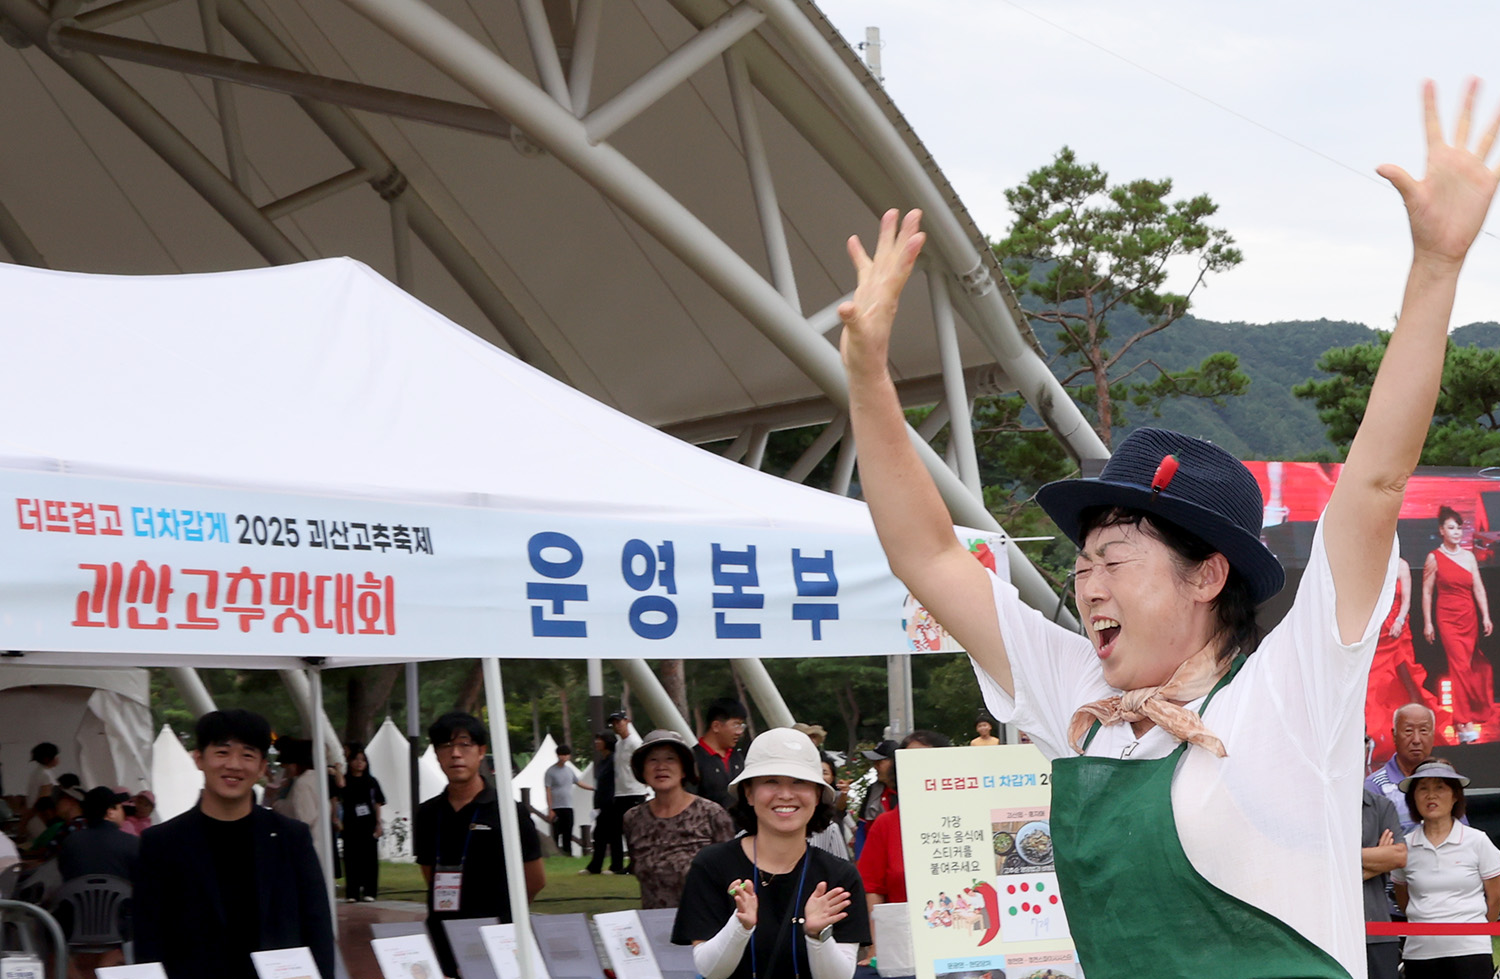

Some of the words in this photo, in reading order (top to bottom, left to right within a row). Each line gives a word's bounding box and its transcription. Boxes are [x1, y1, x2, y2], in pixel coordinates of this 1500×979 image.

[16, 498, 123, 537] 더뜨겁고
[131, 506, 230, 544] 더차갑게
[236, 514, 300, 548] 2025
[308, 519, 434, 554] 괴산고추축제
[71, 560, 396, 636] 괴산고추맛대회
[925, 778, 937, 791] 더
[941, 776, 979, 790] 뜨겁고
[983, 775, 995, 788] 더
[999, 773, 1036, 787] 차갑게
[941, 815, 961, 828] 가장
[920, 831, 952, 845] 맛있는
[954, 829, 984, 843] 음식에
[932, 845, 972, 859] 스티커를
[930, 860, 981, 875] 붙여주세요
